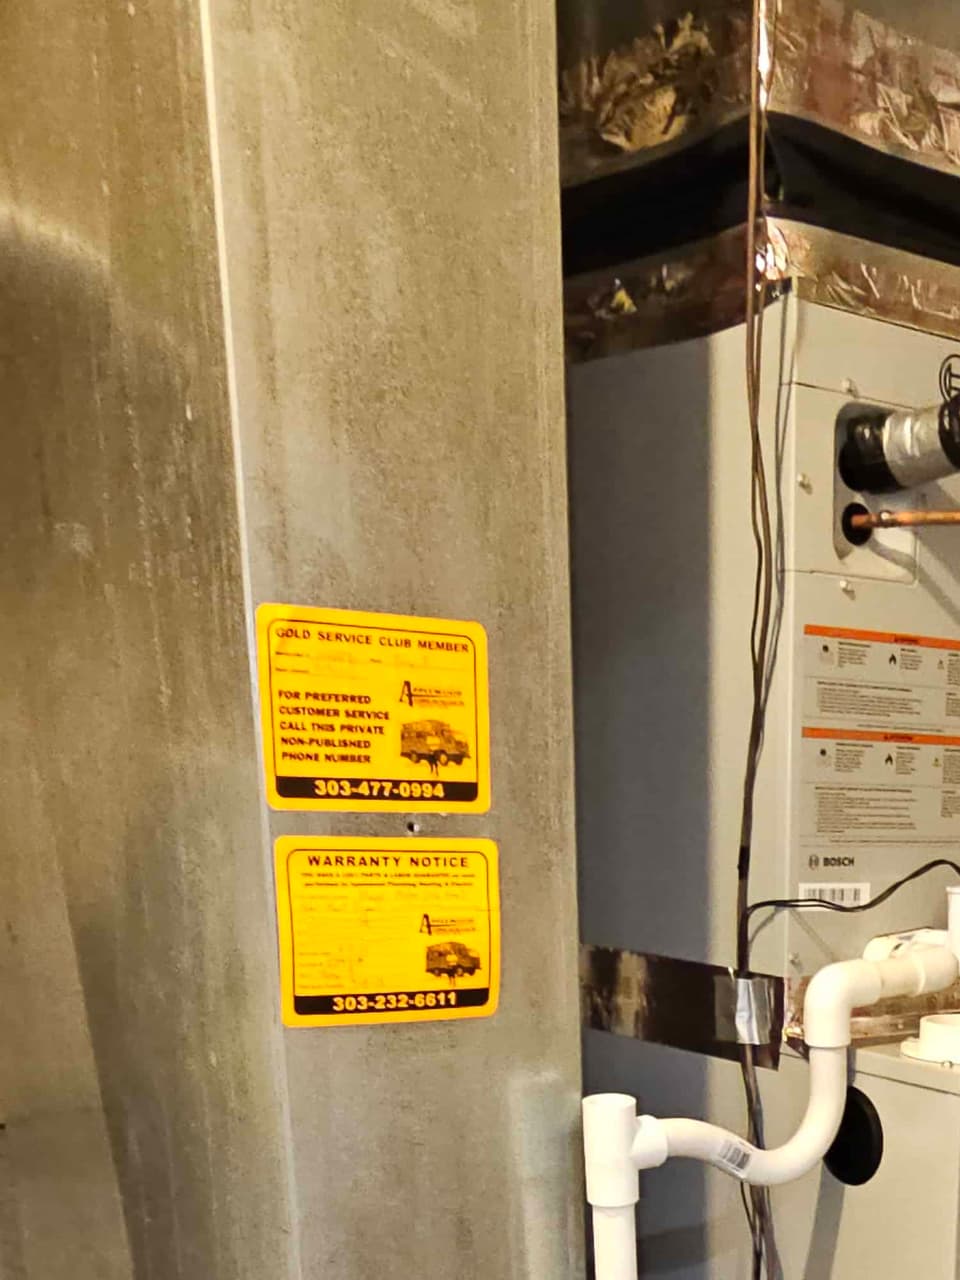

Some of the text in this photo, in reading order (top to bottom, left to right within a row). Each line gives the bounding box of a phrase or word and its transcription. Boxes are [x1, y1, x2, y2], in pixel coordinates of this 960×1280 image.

[276, 628, 469, 653] GOLD SERVICE CLUB MEMBER
[278, 690, 371, 704] FOR PREFERRED
[279, 706, 390, 721] CUSTOMER SERVICE
[279, 721, 385, 735] CALL THIS PRIVATE
[280, 736, 371, 749] NON-PUBLISHED
[281, 751, 371, 764] PHONE NUMBER
[314, 779, 445, 798] 303-477-0994
[307, 855, 469, 868] WARRANTY NOTICE
[823, 856, 855, 867] BOSCH
[332, 991, 457, 1012] 303-232-6611
